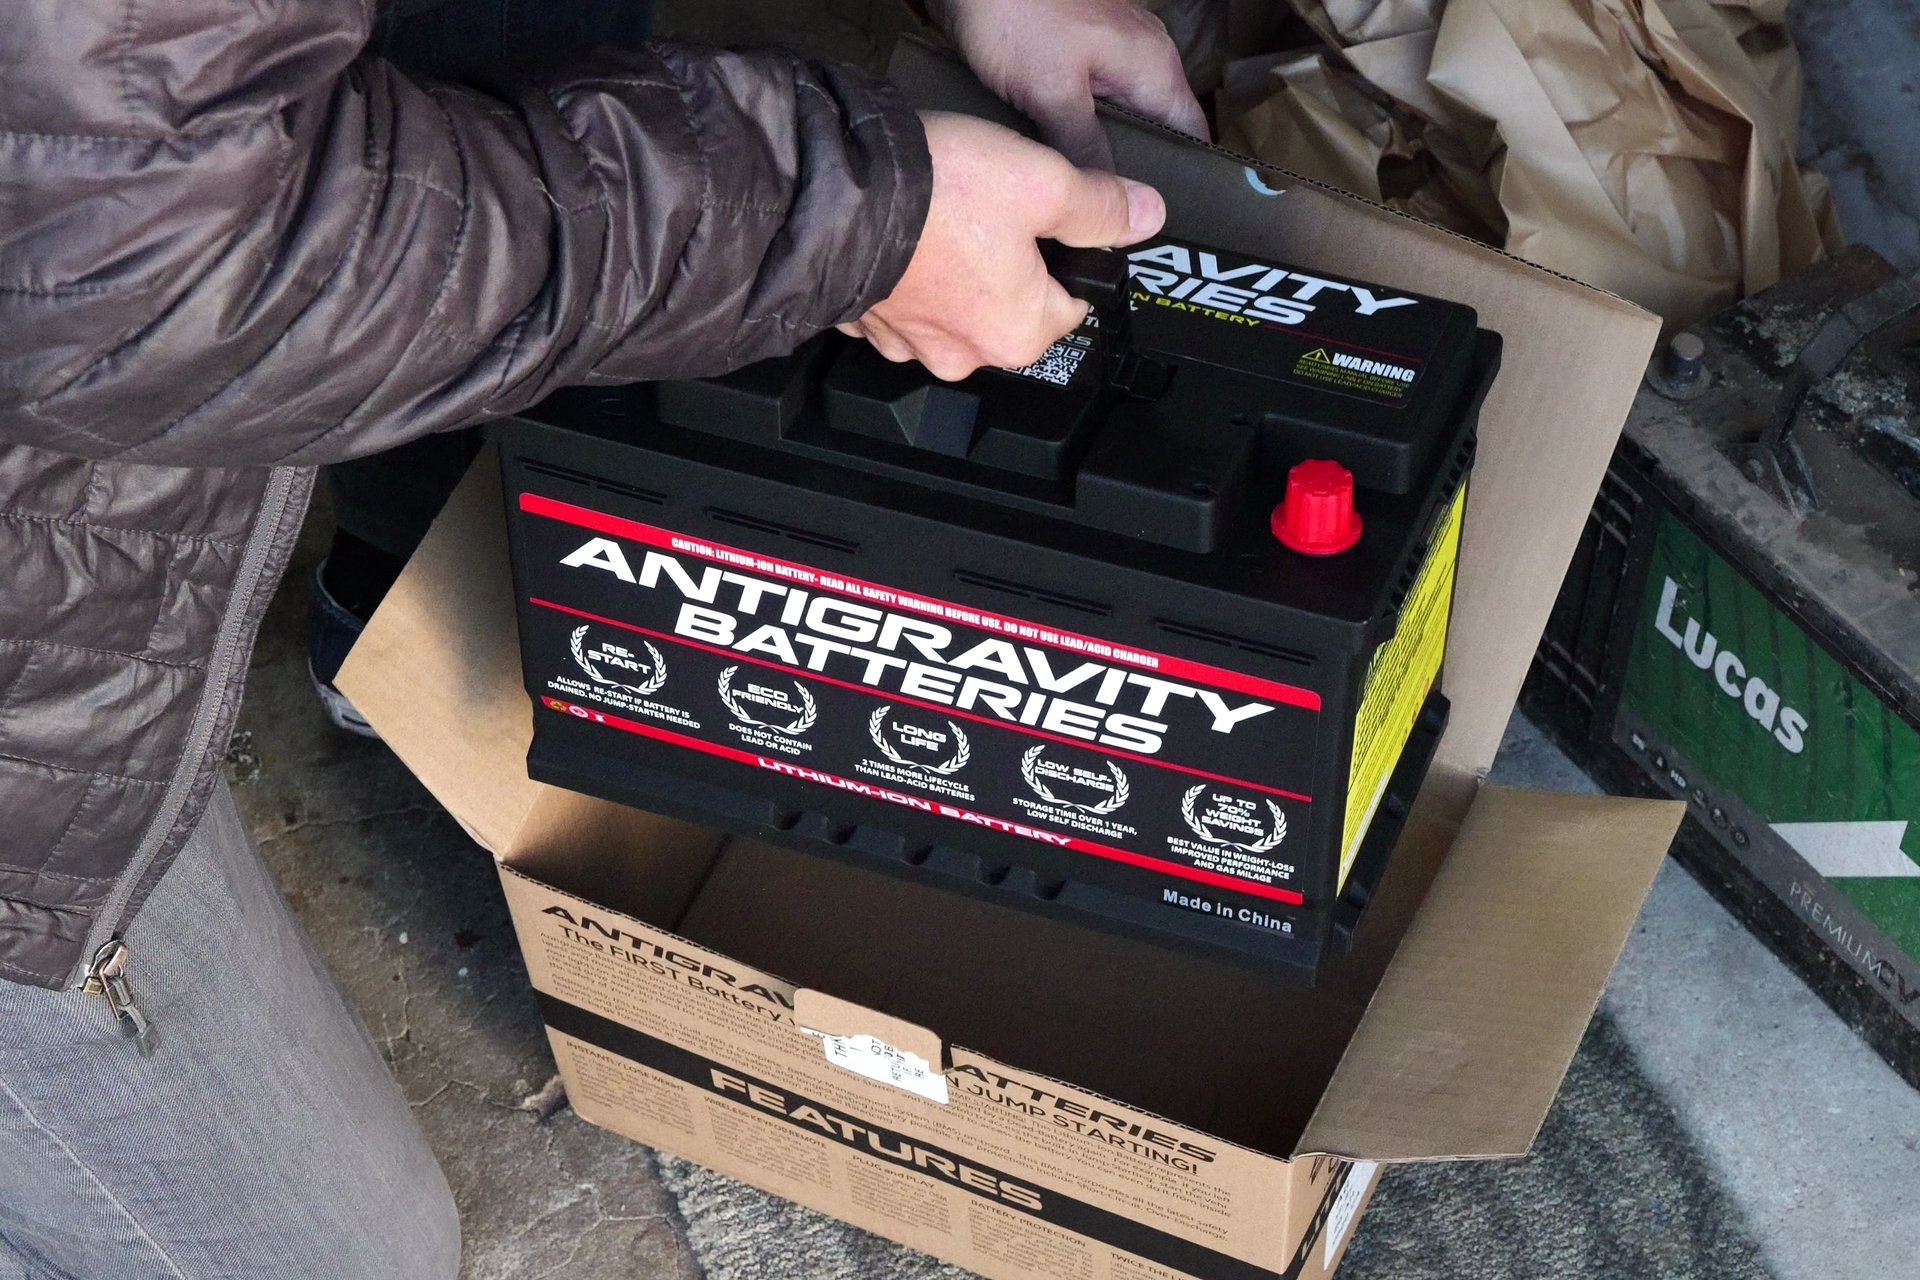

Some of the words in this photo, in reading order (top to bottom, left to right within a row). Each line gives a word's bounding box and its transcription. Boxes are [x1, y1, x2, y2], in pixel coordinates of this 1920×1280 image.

[1127, 244, 1419, 316] AVITY
[1128, 264, 1316, 325] RIES
[1154, 297, 1261, 327] BATTERY
[1331, 352, 1415, 383] WARNING
[672, 538, 714, 557] CAUTION:
[716, 549, 774, 572] LITHIUM-ION
[820, 576, 844, 590] READ
[846, 583, 861, 594] ALL
[863, 587, 896, 603] SAFETY
[898, 596, 943, 615] WARNING
[945, 607, 980, 624] BEFORE
[1004, 622, 1017, 633] DO
[1019, 626, 1038, 638] NOT
[1040, 631, 1058, 643] USE
[1060, 636, 1111, 656] LEAD/ACID
[1113, 649, 1158, 668] CHARGER
[560, 537, 1275, 733] ANTIGRAVITY
[602, 643, 634, 658] RE-
[587, 650, 651, 674] START
[674, 603, 1168, 753] BATTERIES
[1654, 576, 1808, 754] Lucas
[548, 681, 588, 697] DRAINED.
[589, 692, 602, 701] NO
[601, 696, 667, 719] JUMP-STARTER
[666, 712, 700, 728] NEEDED
[556, 676, 591, 694] ALLOWS
[593, 686, 635, 702] RE-START
[632, 697, 642, 705] IF
[644, 700, 680, 715] BATTERY
[732, 689, 804, 717] FRIENDLY
[746, 683, 788, 702] ECO
[729, 723, 754, 738] DOES
[753, 730, 774, 743] NOT
[773, 733, 812, 751] CONTAIN
[741, 734, 766, 745] LEAD
[765, 741, 780, 750] OR
[779, 745, 800, 755] ACID
[893, 722, 946, 743] LONG
[901, 734, 938, 751] LIFE
[854, 764, 879, 776] THAN
[881, 771, 928, 788] LEAD-ACID
[929, 784, 975, 801] BATTERIES
[869, 760, 895, 772] TIMES
[897, 768, 923, 780] MORE
[922, 775, 969, 792] LIFECYCLE
[1035, 765, 1114, 792] DISCHARGE
[1036, 759, 1069, 775] LOW
[758, 758, 931, 810] LITHIUM-ION
[940, 806, 1070, 845] BATTERY
[1013, 798, 1056, 813] STORAGE
[1055, 808, 1079, 821] TIME
[1078, 815, 1103, 829] OVER
[1110, 823, 1137, 835] YEAR,
[1206, 808, 1262, 830] WEIGHT
[1213, 793, 1233, 807] UP
[1236, 799, 1256, 810] TO
[1218, 803, 1250, 818] 70%
[1027, 809, 1047, 819] LOW
[1049, 815, 1069, 825] SELF
[1071, 820, 1122, 839] DISCHARGE
[1202, 816, 1264, 839] SAVINGS
[1167, 836, 1190, 849] BEST
[1191, 842, 1220, 855] VALUE
[1222, 850, 1232, 860] IN
[1231, 852, 1294, 874] WEIGHT-LOSS
[1171, 844, 1219, 863] IMPROVED
[1221, 858, 1289, 879] PERFORMANCE
[1194, 859, 1214, 869] AND
[1216, 865, 1235, 874] GAS
[1237, 869, 1271, 883] MILAGE
[1164, 889, 1211, 911] Made
[1217, 903, 1232, 917] in
[1239, 909, 1291, 932] China
[1790, 880, 1882, 978] PREMIUM
[541, 906, 795, 1010] ANTIGRAV
[952, 1063, 1216, 1163] ATTERIES
[559, 924, 604, 951] The
[605, 943, 682, 982] FIRST
[688, 977, 781, 1022] Battery
[966, 1074, 1047, 1118] JUMP
[1052, 1113, 1198, 1174] STARTING!
[565, 1040, 623, 1068] INSTANTLY
[623, 1063, 650, 1079] LOSE
[652, 1075, 685, 1092] WEIGHT
[703, 1095, 749, 1118] WIRELESS
[787, 1129, 826, 1149] REMOTE
[710, 1069, 1043, 1211] FEATURES
[852, 1155, 881, 1171] PLUG
[883, 1167, 904, 1179] and
[905, 1174, 935, 1190] PLAY
[970, 1199, 1016, 1221] BATTERY
[1019, 1217, 1085, 1247] PROTECTION
[1111, 1251, 1144, 1269] TWICE
[1148, 1265, 1168, 1278] THE
